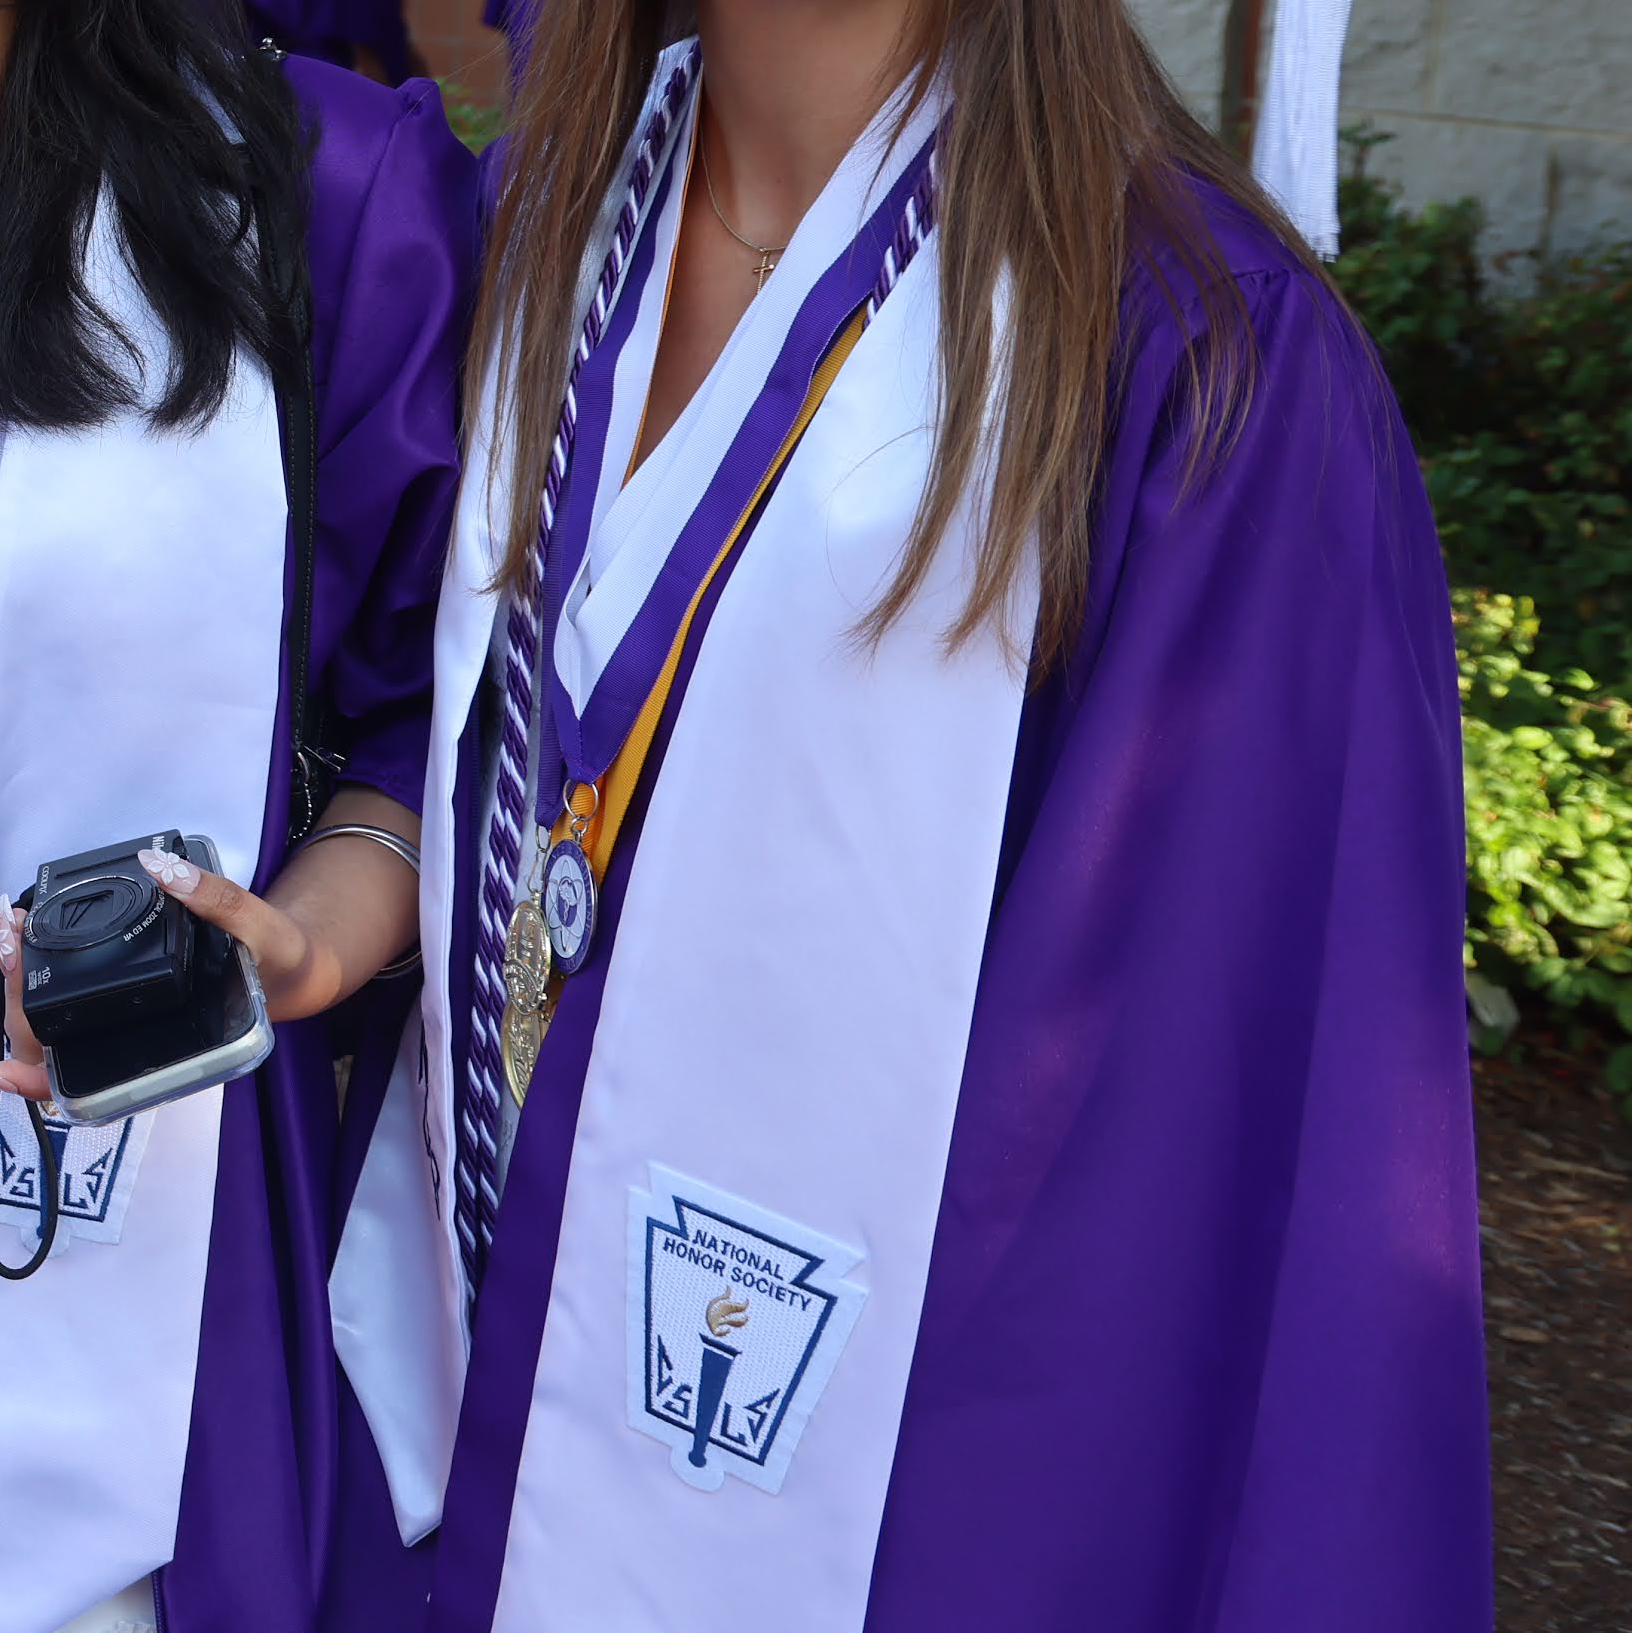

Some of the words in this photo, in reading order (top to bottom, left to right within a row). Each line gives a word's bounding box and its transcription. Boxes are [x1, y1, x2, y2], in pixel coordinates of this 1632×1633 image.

[141, 911, 159, 929] ZOOM
[123, 931, 136, 942] VR
[132, 924, 144, 936] ED
[42, 966, 52, 985] 10x
[693, 1229, 784, 1282] NATIONAL
[663, 1236, 726, 1277] HONOR
[730, 1267, 812, 1312] SOCIETY
